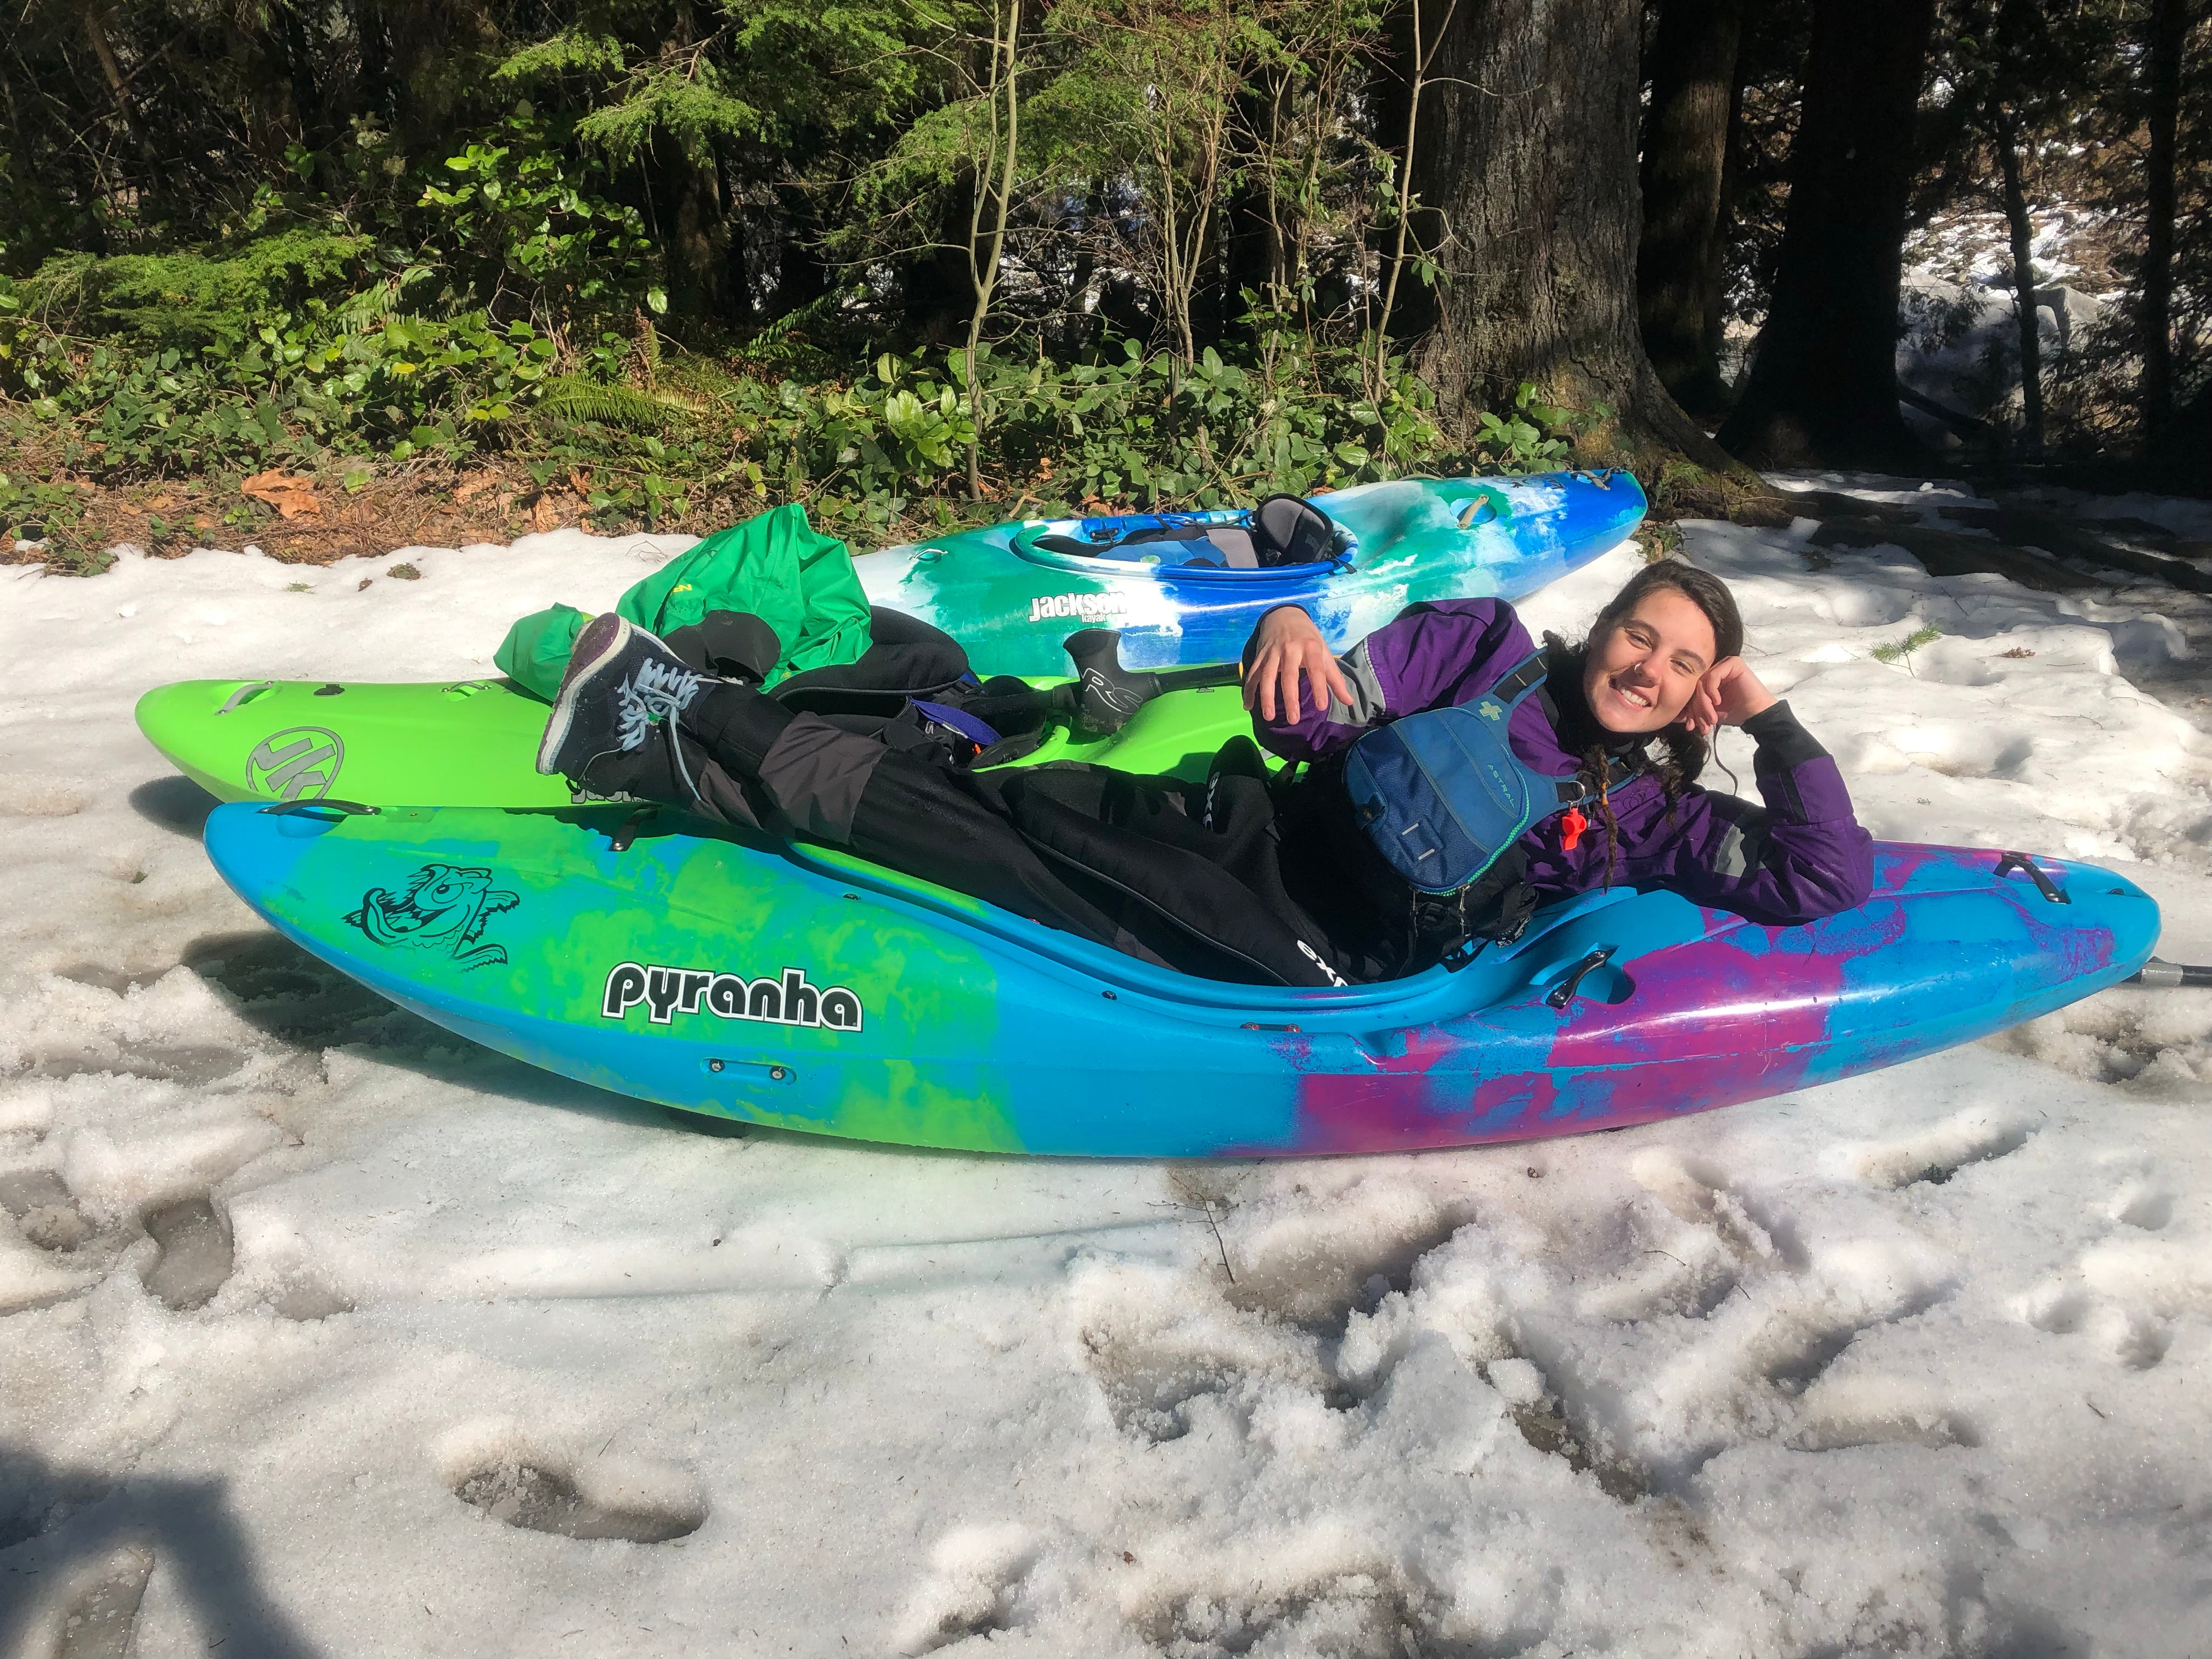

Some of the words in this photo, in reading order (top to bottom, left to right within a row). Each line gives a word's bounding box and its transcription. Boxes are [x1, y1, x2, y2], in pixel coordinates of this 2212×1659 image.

[1081, 613, 1107, 623] kayak
[1487, 764, 1514, 808] ASTRAL
[601, 961, 864, 1032] pyranha
